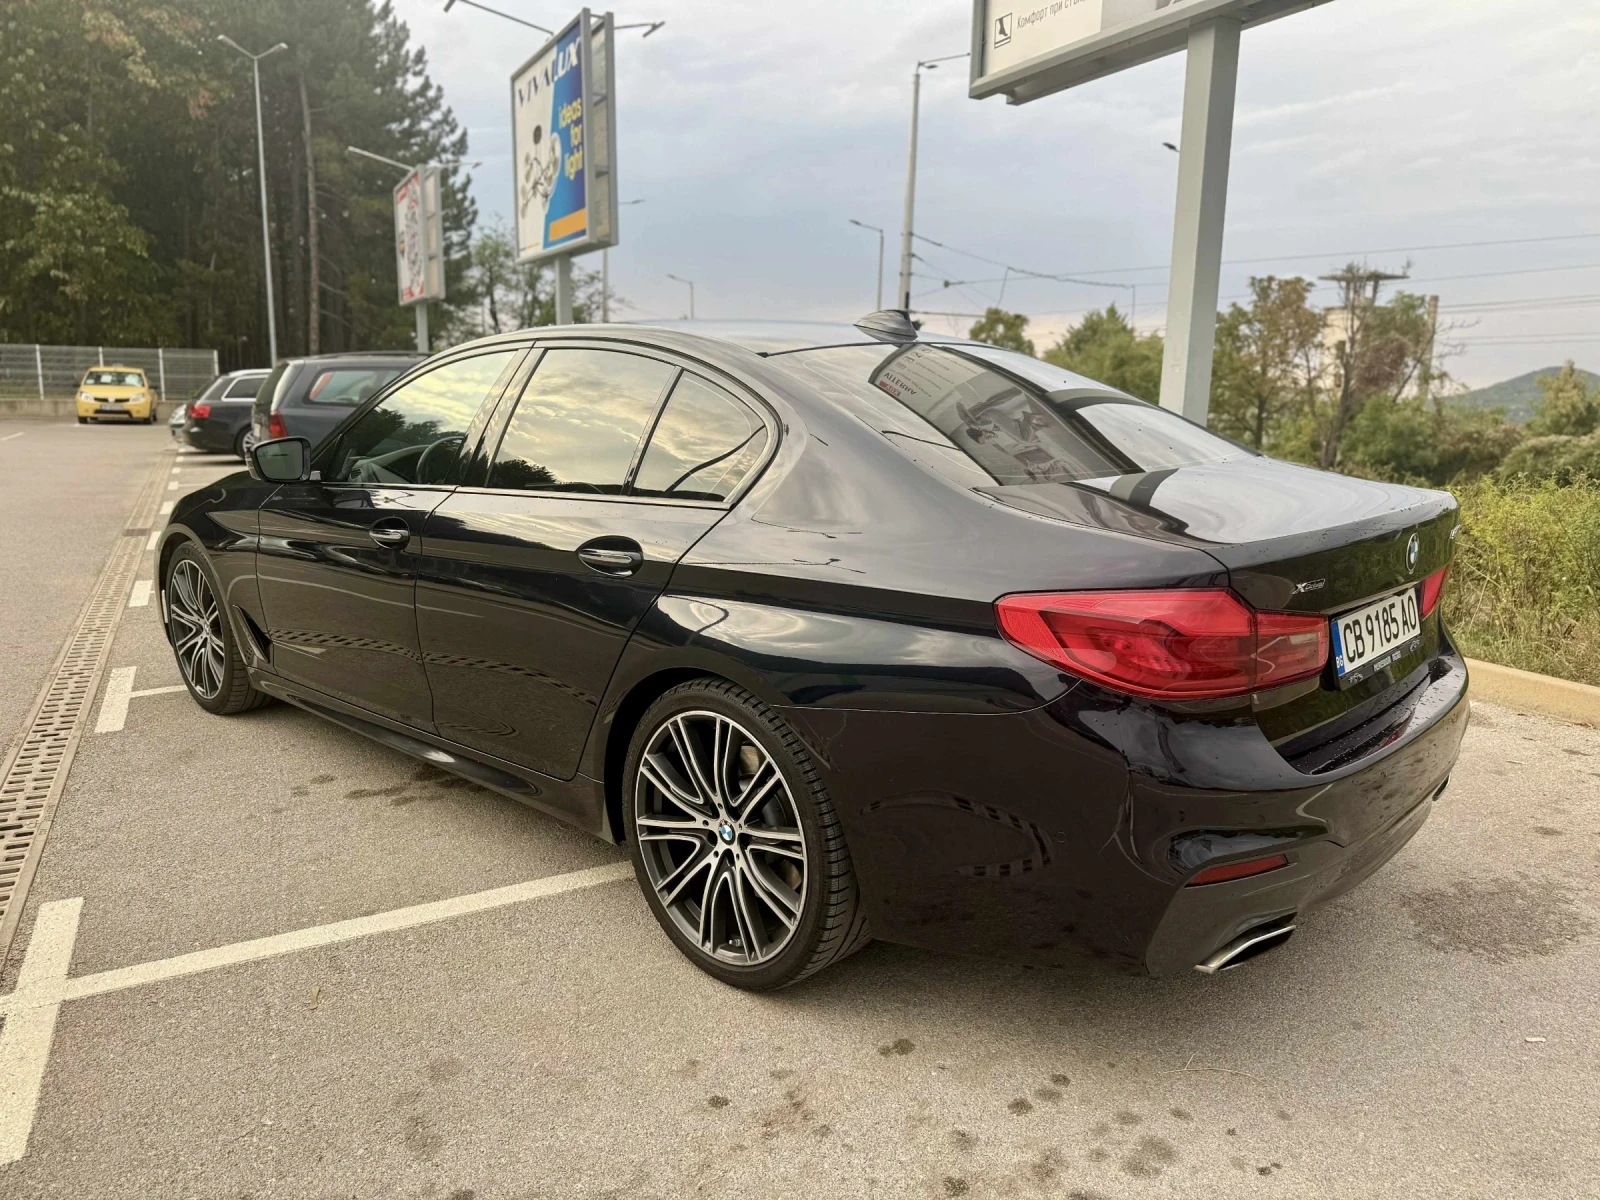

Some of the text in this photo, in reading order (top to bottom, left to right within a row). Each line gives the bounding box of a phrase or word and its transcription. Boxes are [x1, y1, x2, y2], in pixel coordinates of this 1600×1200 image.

[1017, 7, 1048, 29] Комфорт
[1050, 1, 1062, 16] при
[559, 97, 581, 129] ideas
[570, 124, 582, 148] for
[564, 145, 583, 180] light
[1343, 619, 1365, 663] CB
[1365, 602, 1399, 654] 9185
[1401, 595, 1417, 636] AO
[1335, 654, 1344, 669] BG
